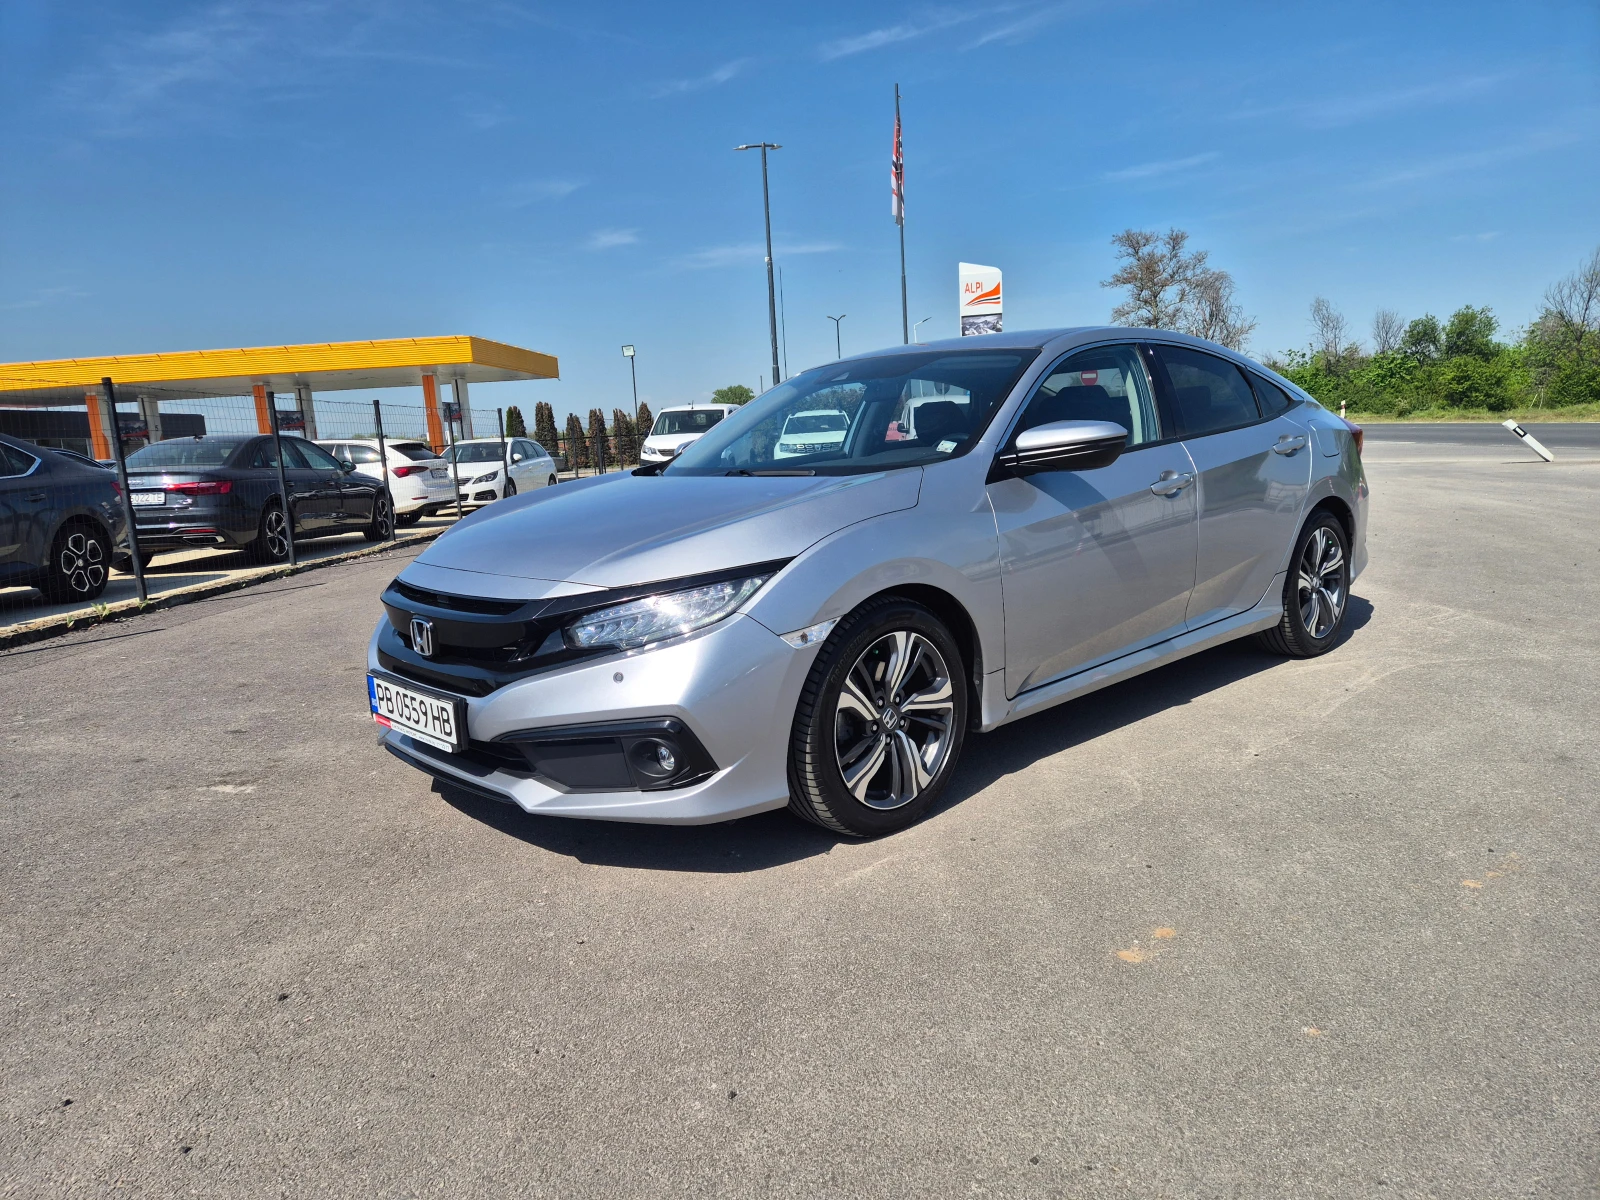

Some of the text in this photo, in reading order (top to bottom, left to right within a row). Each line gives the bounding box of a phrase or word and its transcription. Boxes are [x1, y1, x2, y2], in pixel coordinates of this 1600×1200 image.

[964, 281, 983, 294] ALPI
[376, 683, 394, 714] PB
[395, 690, 428, 728] 0559
[430, 702, 453, 737] HB
